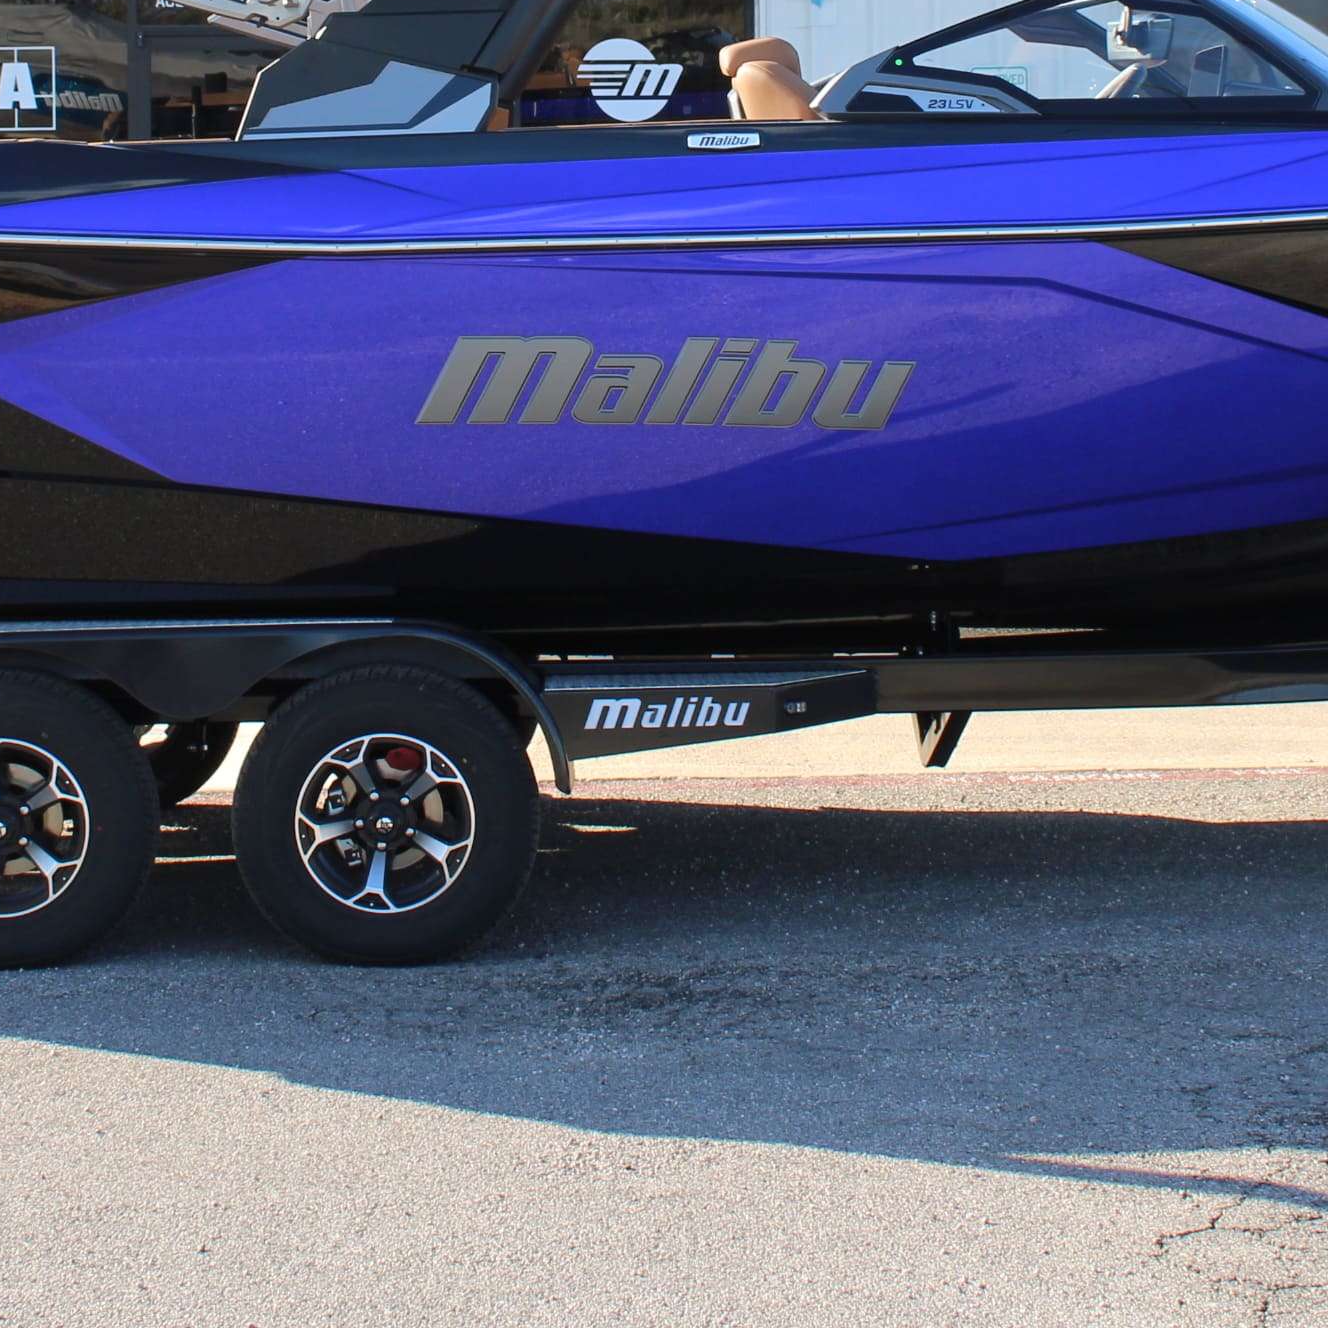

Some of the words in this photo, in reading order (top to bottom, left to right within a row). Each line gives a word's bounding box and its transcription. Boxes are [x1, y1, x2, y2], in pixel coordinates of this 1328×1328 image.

[698, 134, 750, 147] Malibu
[414, 334, 917, 432] Malibu
[583, 696, 751, 730] Malibu
